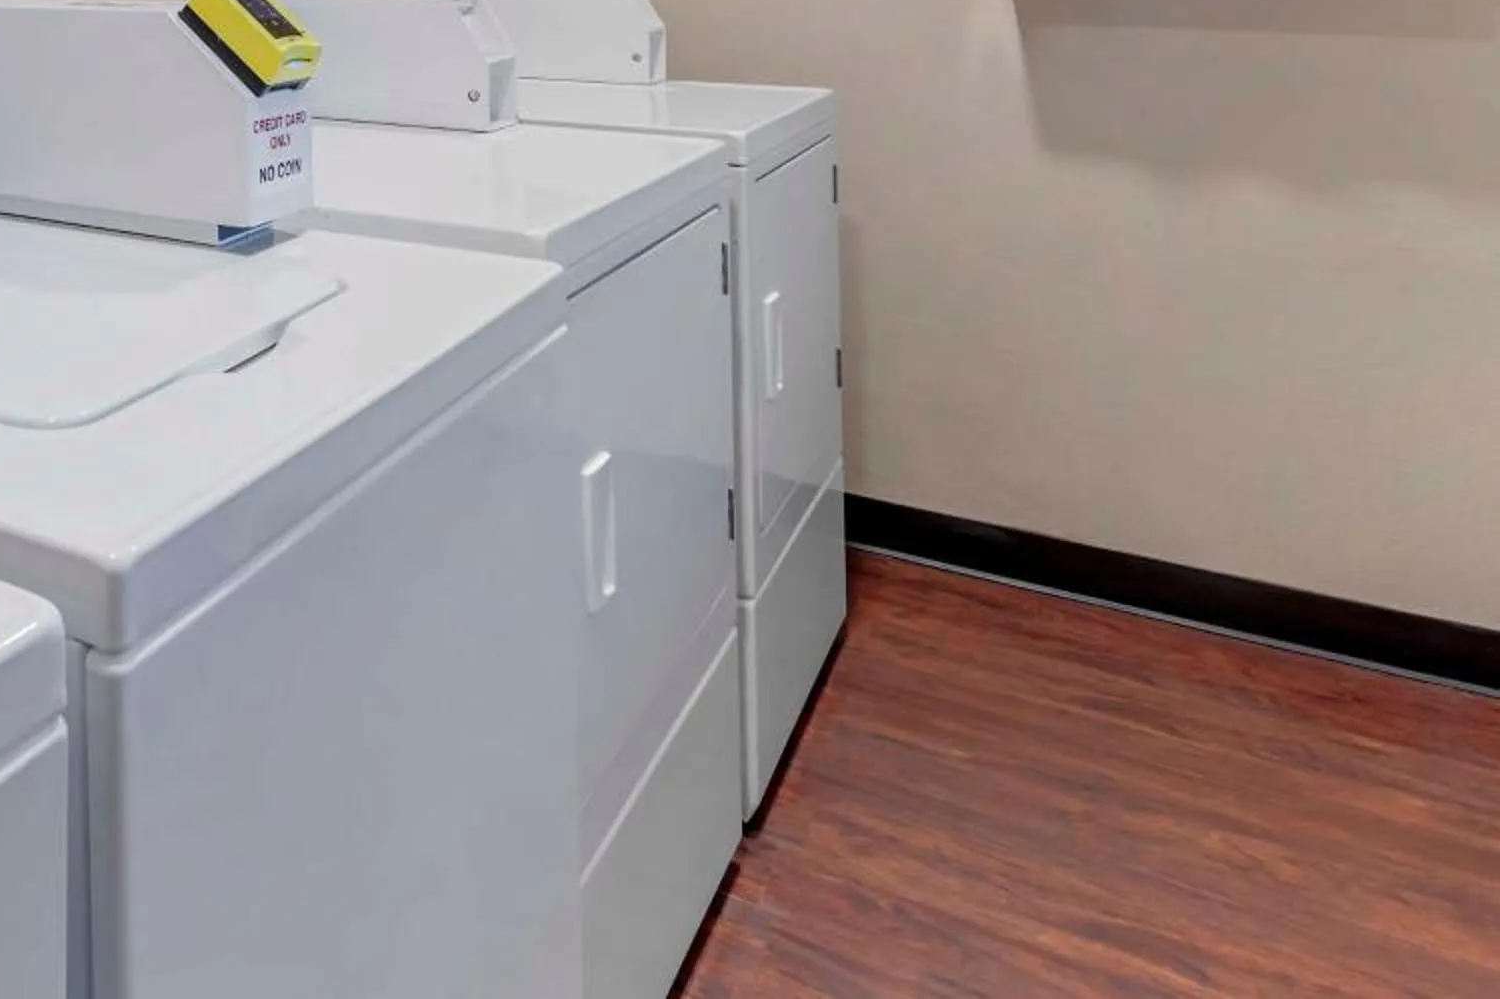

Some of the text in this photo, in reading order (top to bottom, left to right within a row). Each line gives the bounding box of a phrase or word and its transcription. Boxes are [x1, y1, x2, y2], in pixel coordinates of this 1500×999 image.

[253, 116, 283, 134] CREDIT
[259, 158, 302, 184] NO COIN
